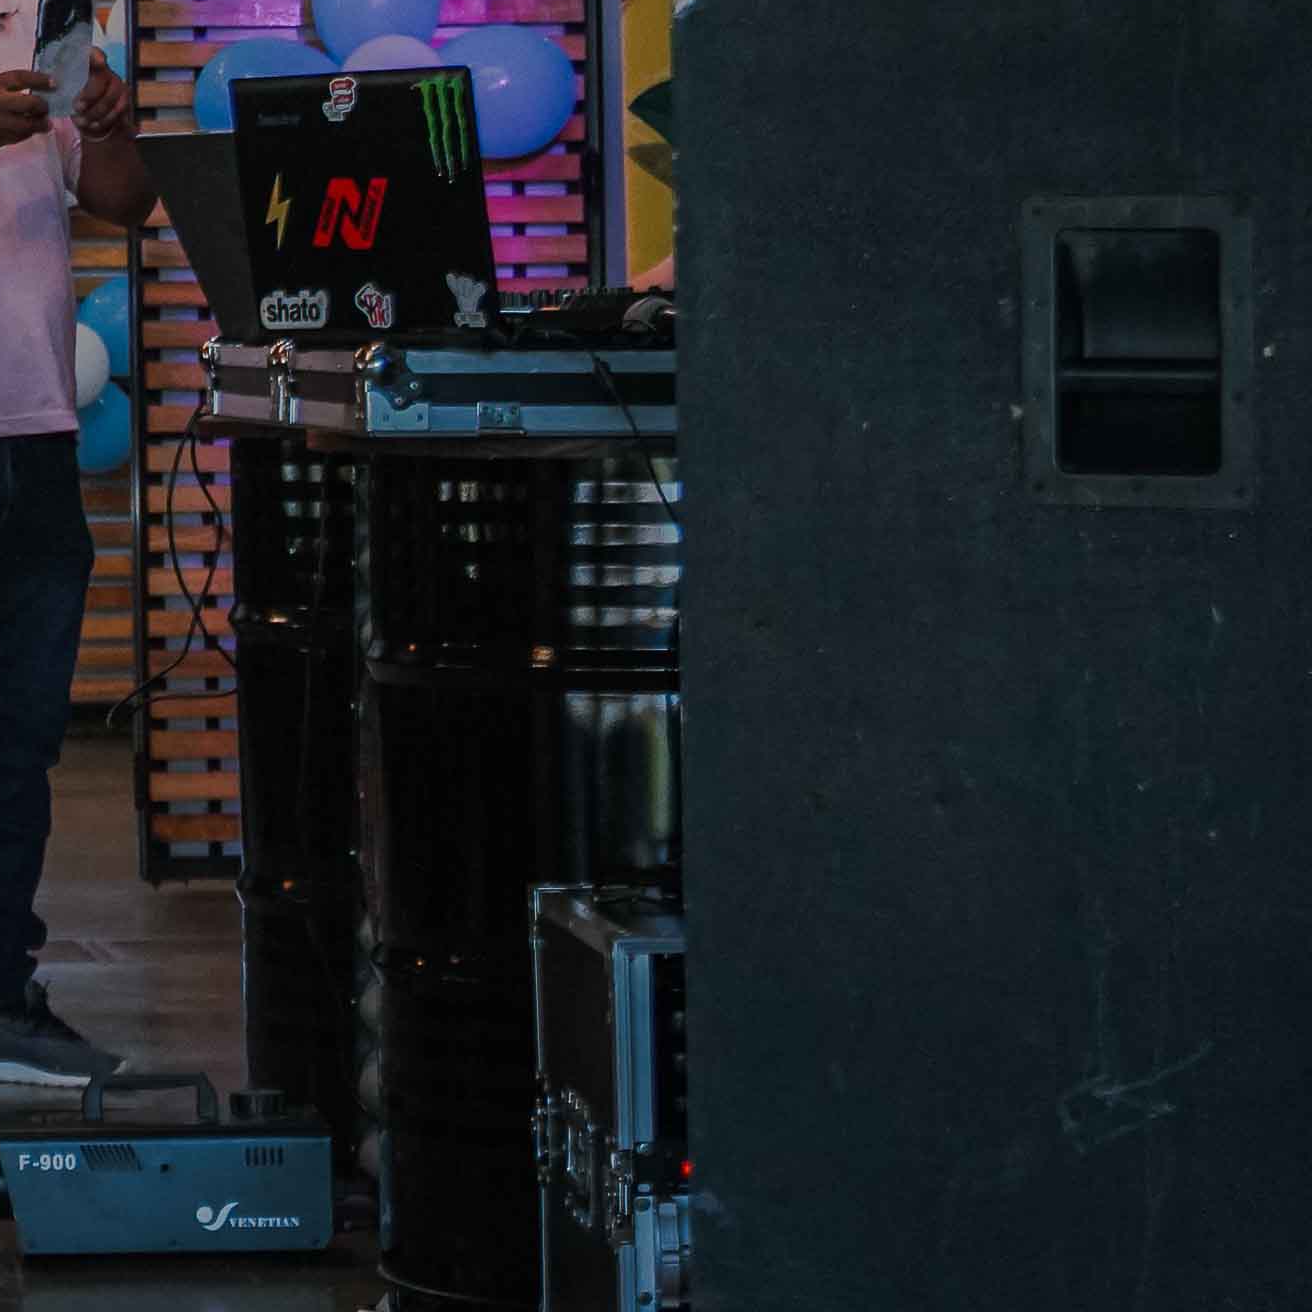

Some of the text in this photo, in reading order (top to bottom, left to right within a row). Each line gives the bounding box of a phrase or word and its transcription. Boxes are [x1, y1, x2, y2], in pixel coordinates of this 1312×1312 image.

[265, 296, 321, 322] shato
[18, 1153, 77, 1172] F-900
[229, 1216, 301, 1229] VENETIAN
